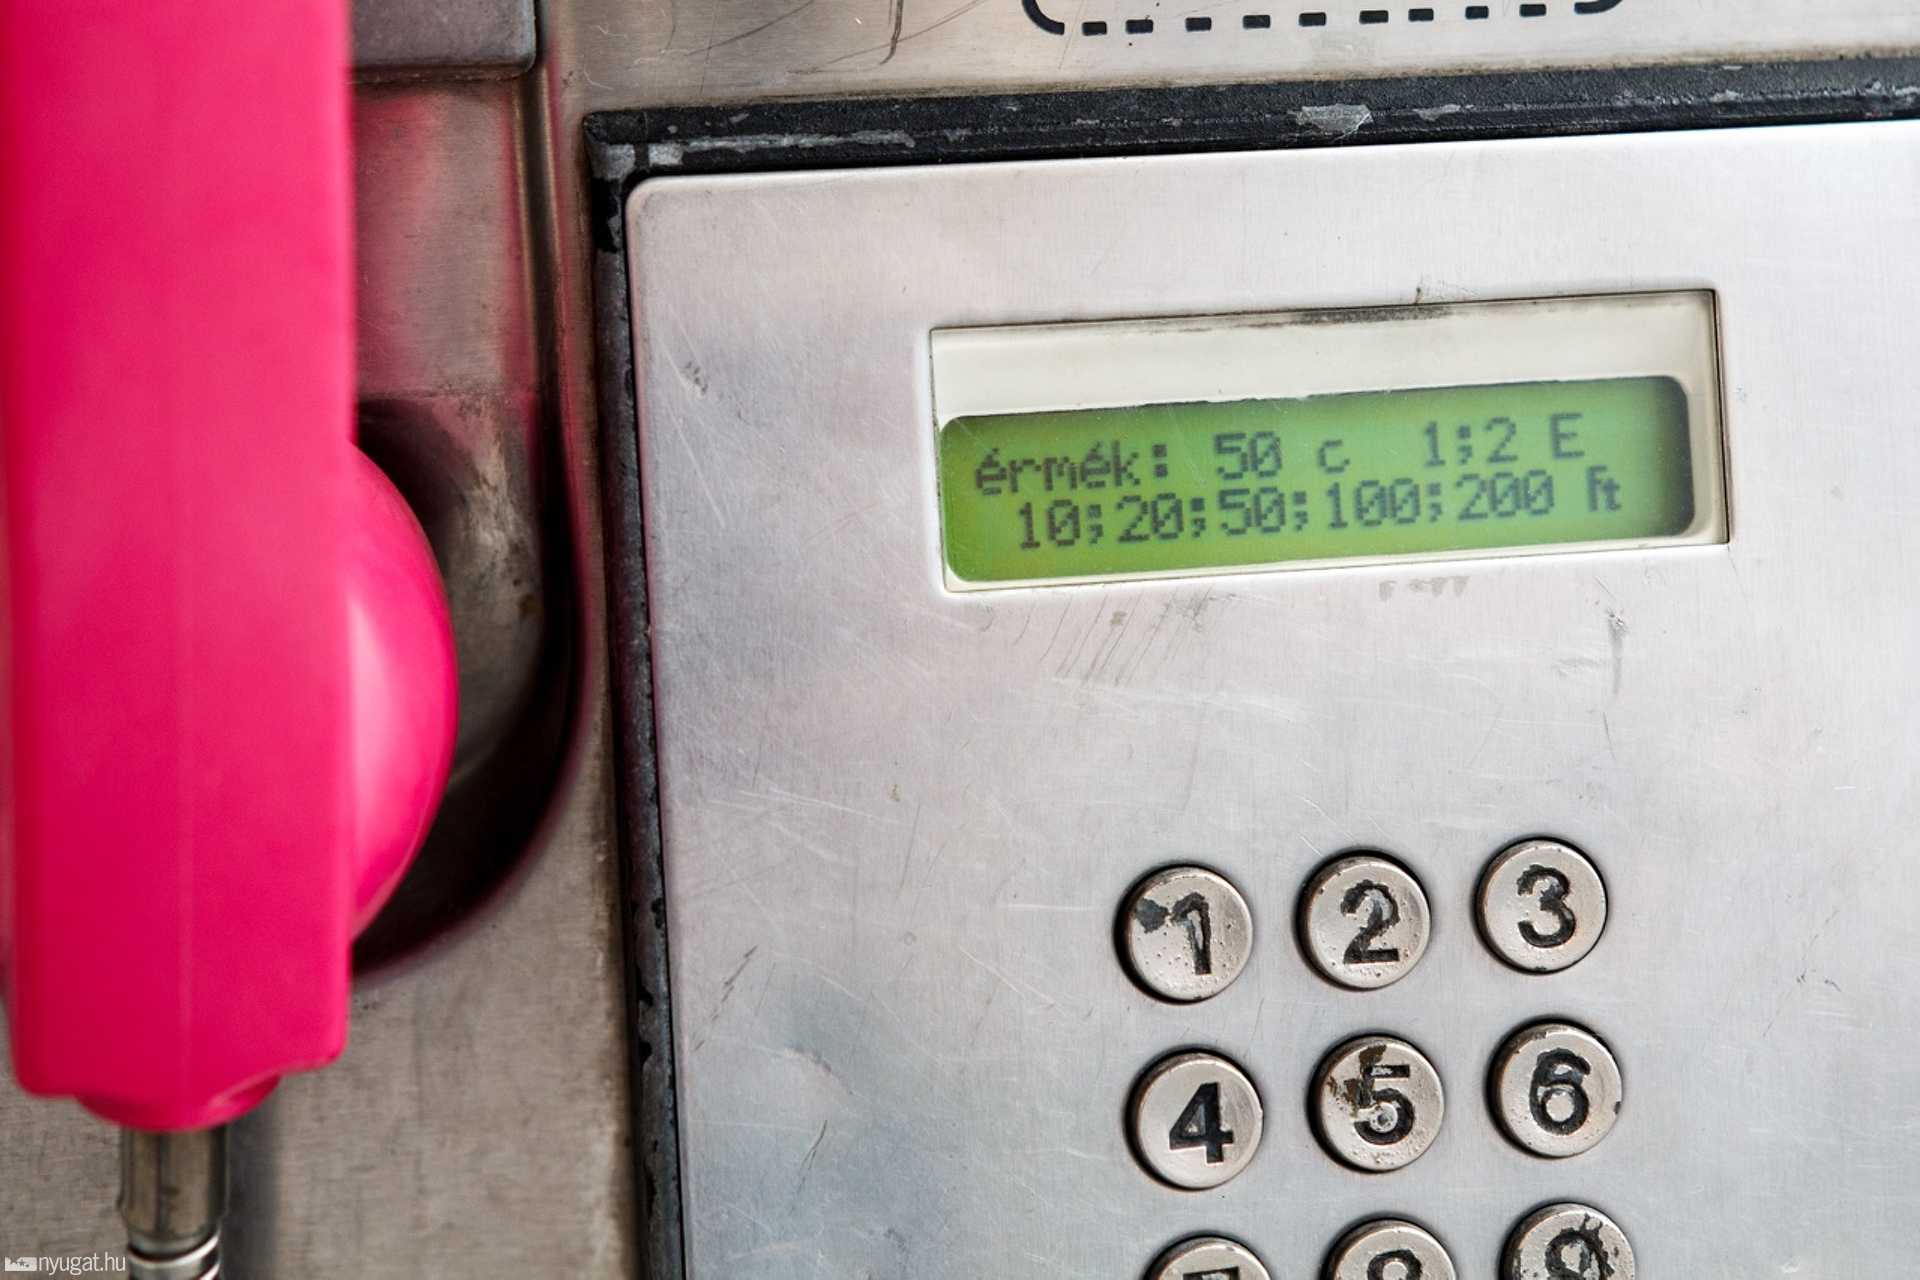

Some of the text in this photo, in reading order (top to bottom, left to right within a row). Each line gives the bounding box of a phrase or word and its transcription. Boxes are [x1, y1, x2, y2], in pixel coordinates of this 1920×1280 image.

[975, 412, 1585, 496] érmék: 50 c 1;2 E
[1018, 468, 1556, 550] 10;20;50;100;200
[1169, 891, 1212, 975] 1
[1340, 879, 1400, 964] 2
[1516, 864, 1576, 948] 3
[1168, 1082, 1234, 1164] 4
[1354, 1064, 1416, 1145] 5
[1529, 1047, 1591, 1136] 6
